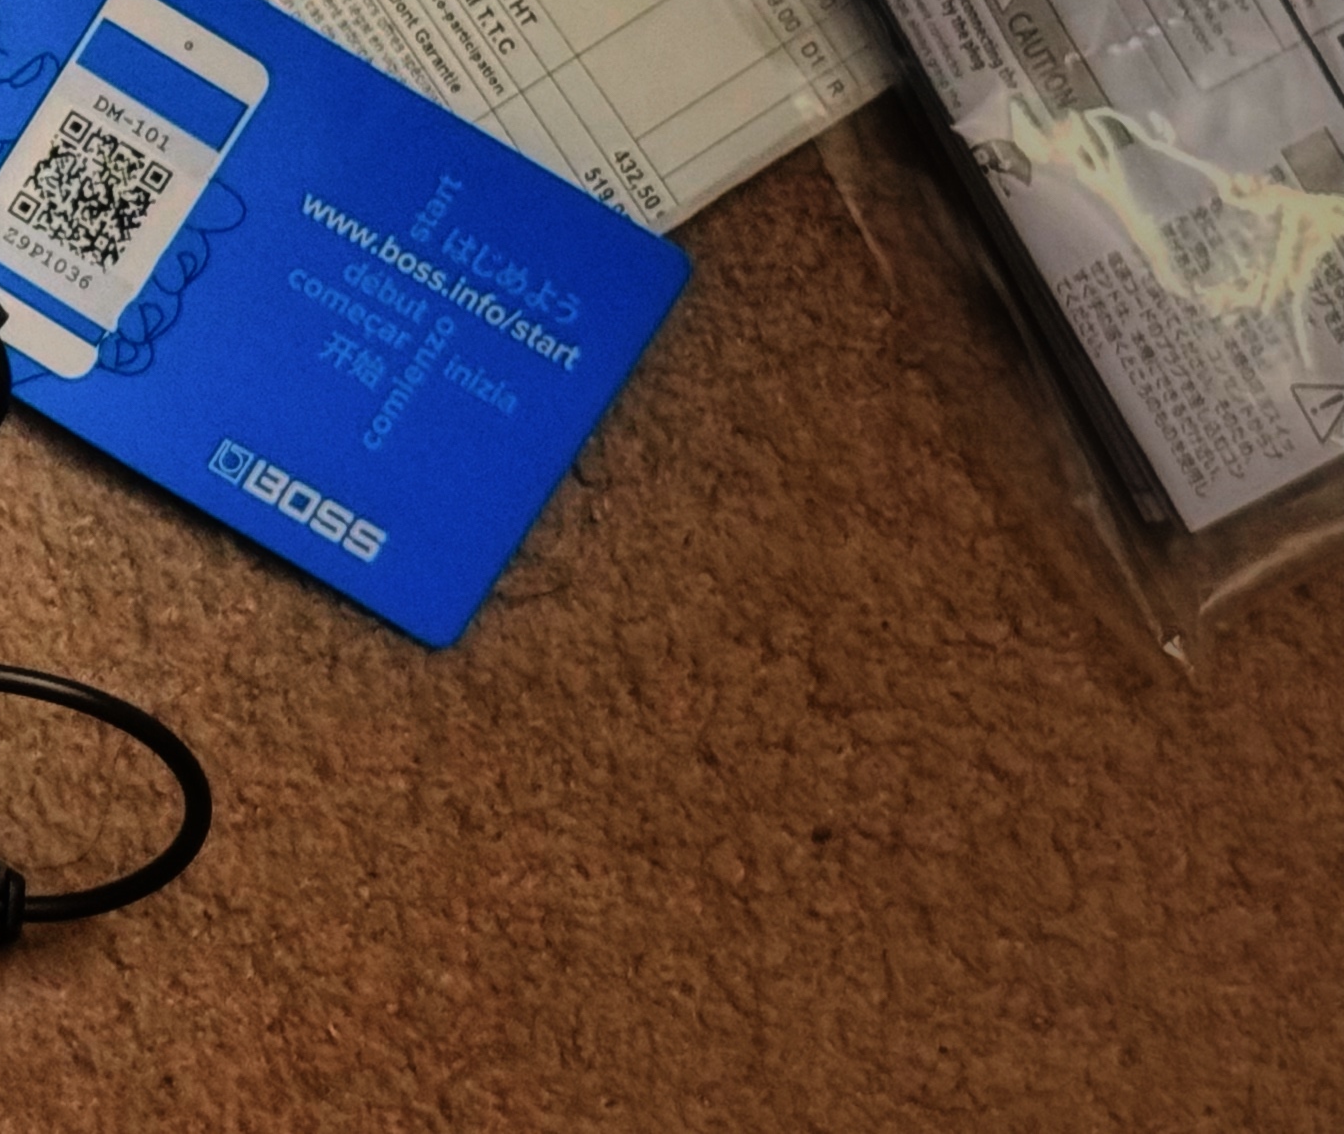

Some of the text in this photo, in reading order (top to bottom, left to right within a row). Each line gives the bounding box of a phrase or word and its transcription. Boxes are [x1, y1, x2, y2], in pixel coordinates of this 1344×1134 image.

[414, 27, 461, 94] Garantie
[476, 4, 516, 55] T.T.C
[1006, 6, 1080, 108] CAUTION
[826, 78, 845, 96] R
[92, 94, 170, 153] DM-101
[409, 173, 463, 243] start
[286, 267, 412, 349] começar
[301, 192, 582, 373] www.boss.info/start
[342, 262, 428, 324] début
[441, 226, 582, 326] はじめよう
[316, 330, 386, 391] 开始
[361, 314, 457, 451] comienzo
[442, 353, 519, 417] inizia
[241, 459, 387, 563] BOSS
